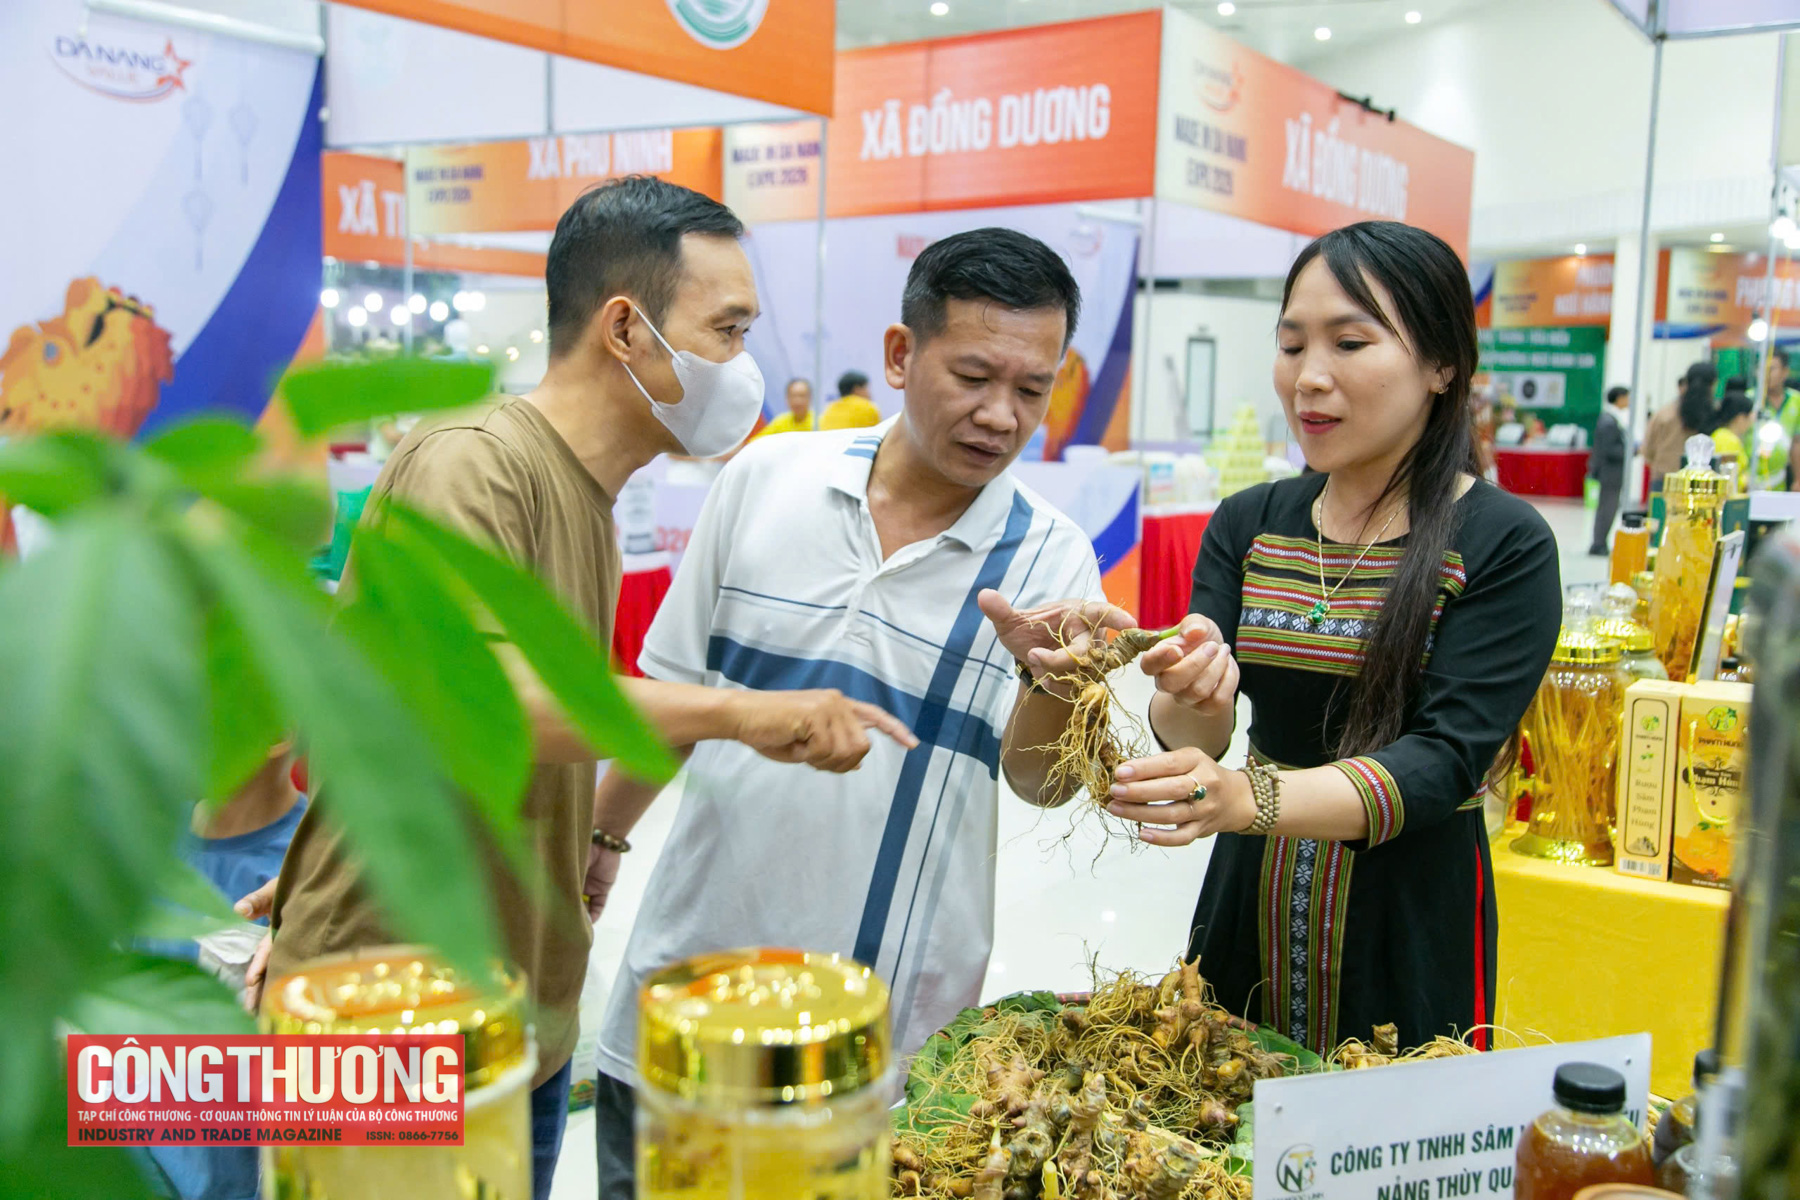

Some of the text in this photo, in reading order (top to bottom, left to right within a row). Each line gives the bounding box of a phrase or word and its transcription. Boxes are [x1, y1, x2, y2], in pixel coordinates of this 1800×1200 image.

[860, 98, 902, 160] XÃ
[998, 83, 1111, 149] DƯƠNG
[613, 129, 673, 174] NINH
[338, 180, 379, 237] XÃ
[1330, 1124, 1513, 1176] CÔNG TY TNHH SÂM
[1436, 1168, 1482, 1200] THÙY
[1488, 1165, 1517, 1193] QU
